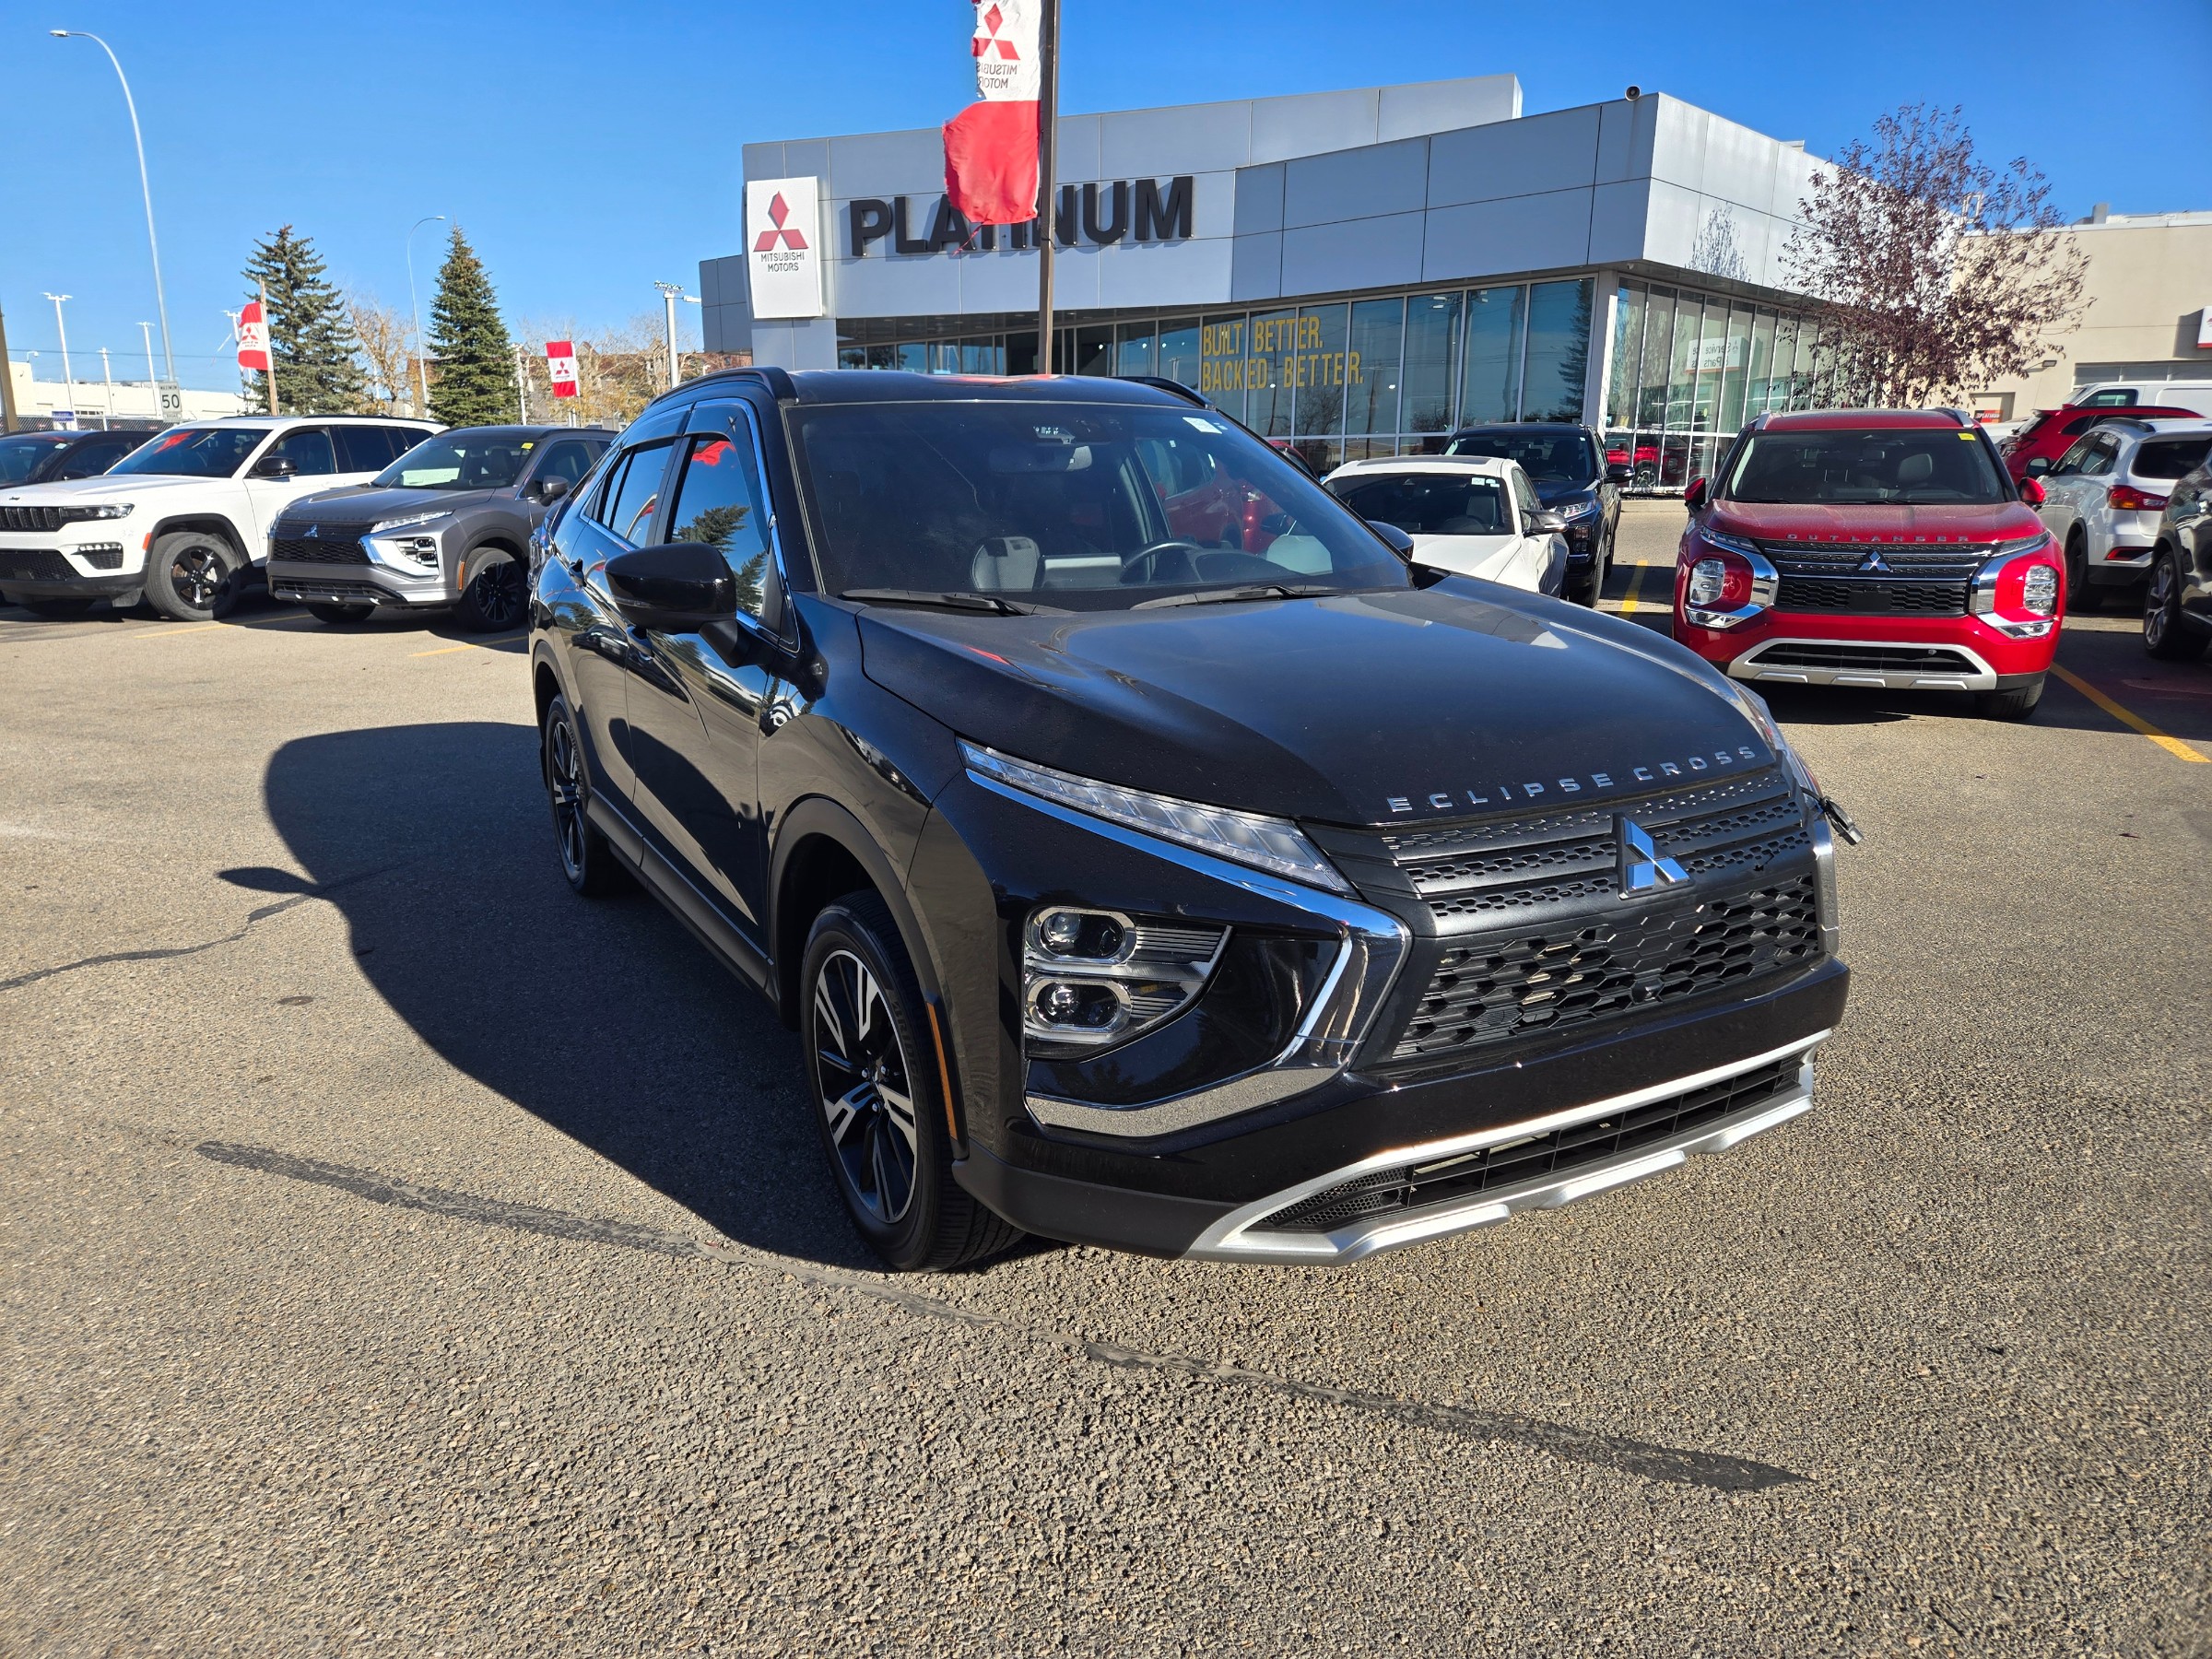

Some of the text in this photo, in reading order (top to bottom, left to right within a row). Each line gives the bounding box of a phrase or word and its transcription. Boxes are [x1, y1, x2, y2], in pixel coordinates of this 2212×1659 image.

[760, 252, 805, 262] MITSUBISHI
[767, 263, 799, 272] MOTORS
[1203, 316, 1324, 357] BUILT BETTER.
[1202, 351, 1364, 392] BACKED BETTER.
[162, 394, 180, 408] 50
[1786, 534, 1969, 542] OUTLANDER
[1386, 746, 1756, 813] ECLIPSE CROSS
